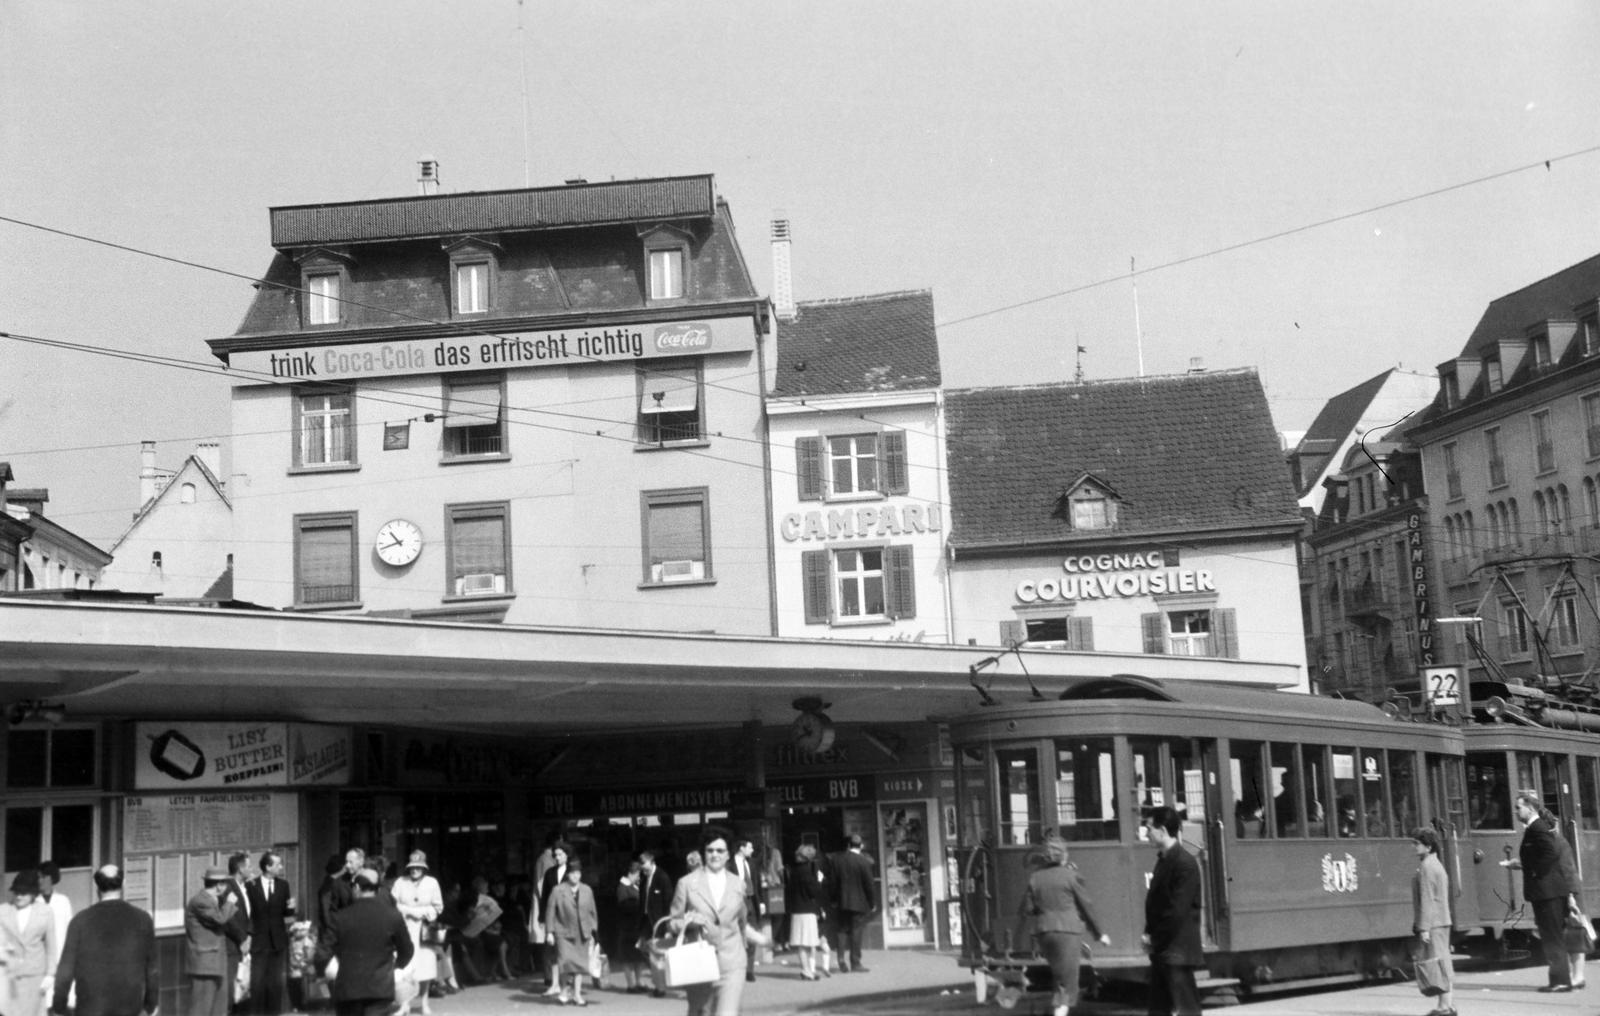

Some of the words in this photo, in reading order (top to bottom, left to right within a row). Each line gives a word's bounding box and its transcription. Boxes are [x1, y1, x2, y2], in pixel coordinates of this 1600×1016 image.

[271, 352, 317, 378] trink
[323, 344, 425, 375] Coca-Cola
[434, 342, 471, 367] das
[480, 332, 570, 364] erfrischt
[577, 329, 644, 357] richtig
[781, 502, 942, 542] CAMPARI
[1063, 550, 1160, 573] COGNAC
[1015, 568, 1216, 602] COURVOISIER
[1409, 513, 1433, 667] GAMBRINUS
[1430, 673, 1458, 699] 22
[227, 727, 268, 750] LISY
[214, 743, 284, 773] BUTTER
[545, 794, 574, 814] BVB
[829, 779, 859, 799] BVB
[883, 781, 914, 792] KIOSK
